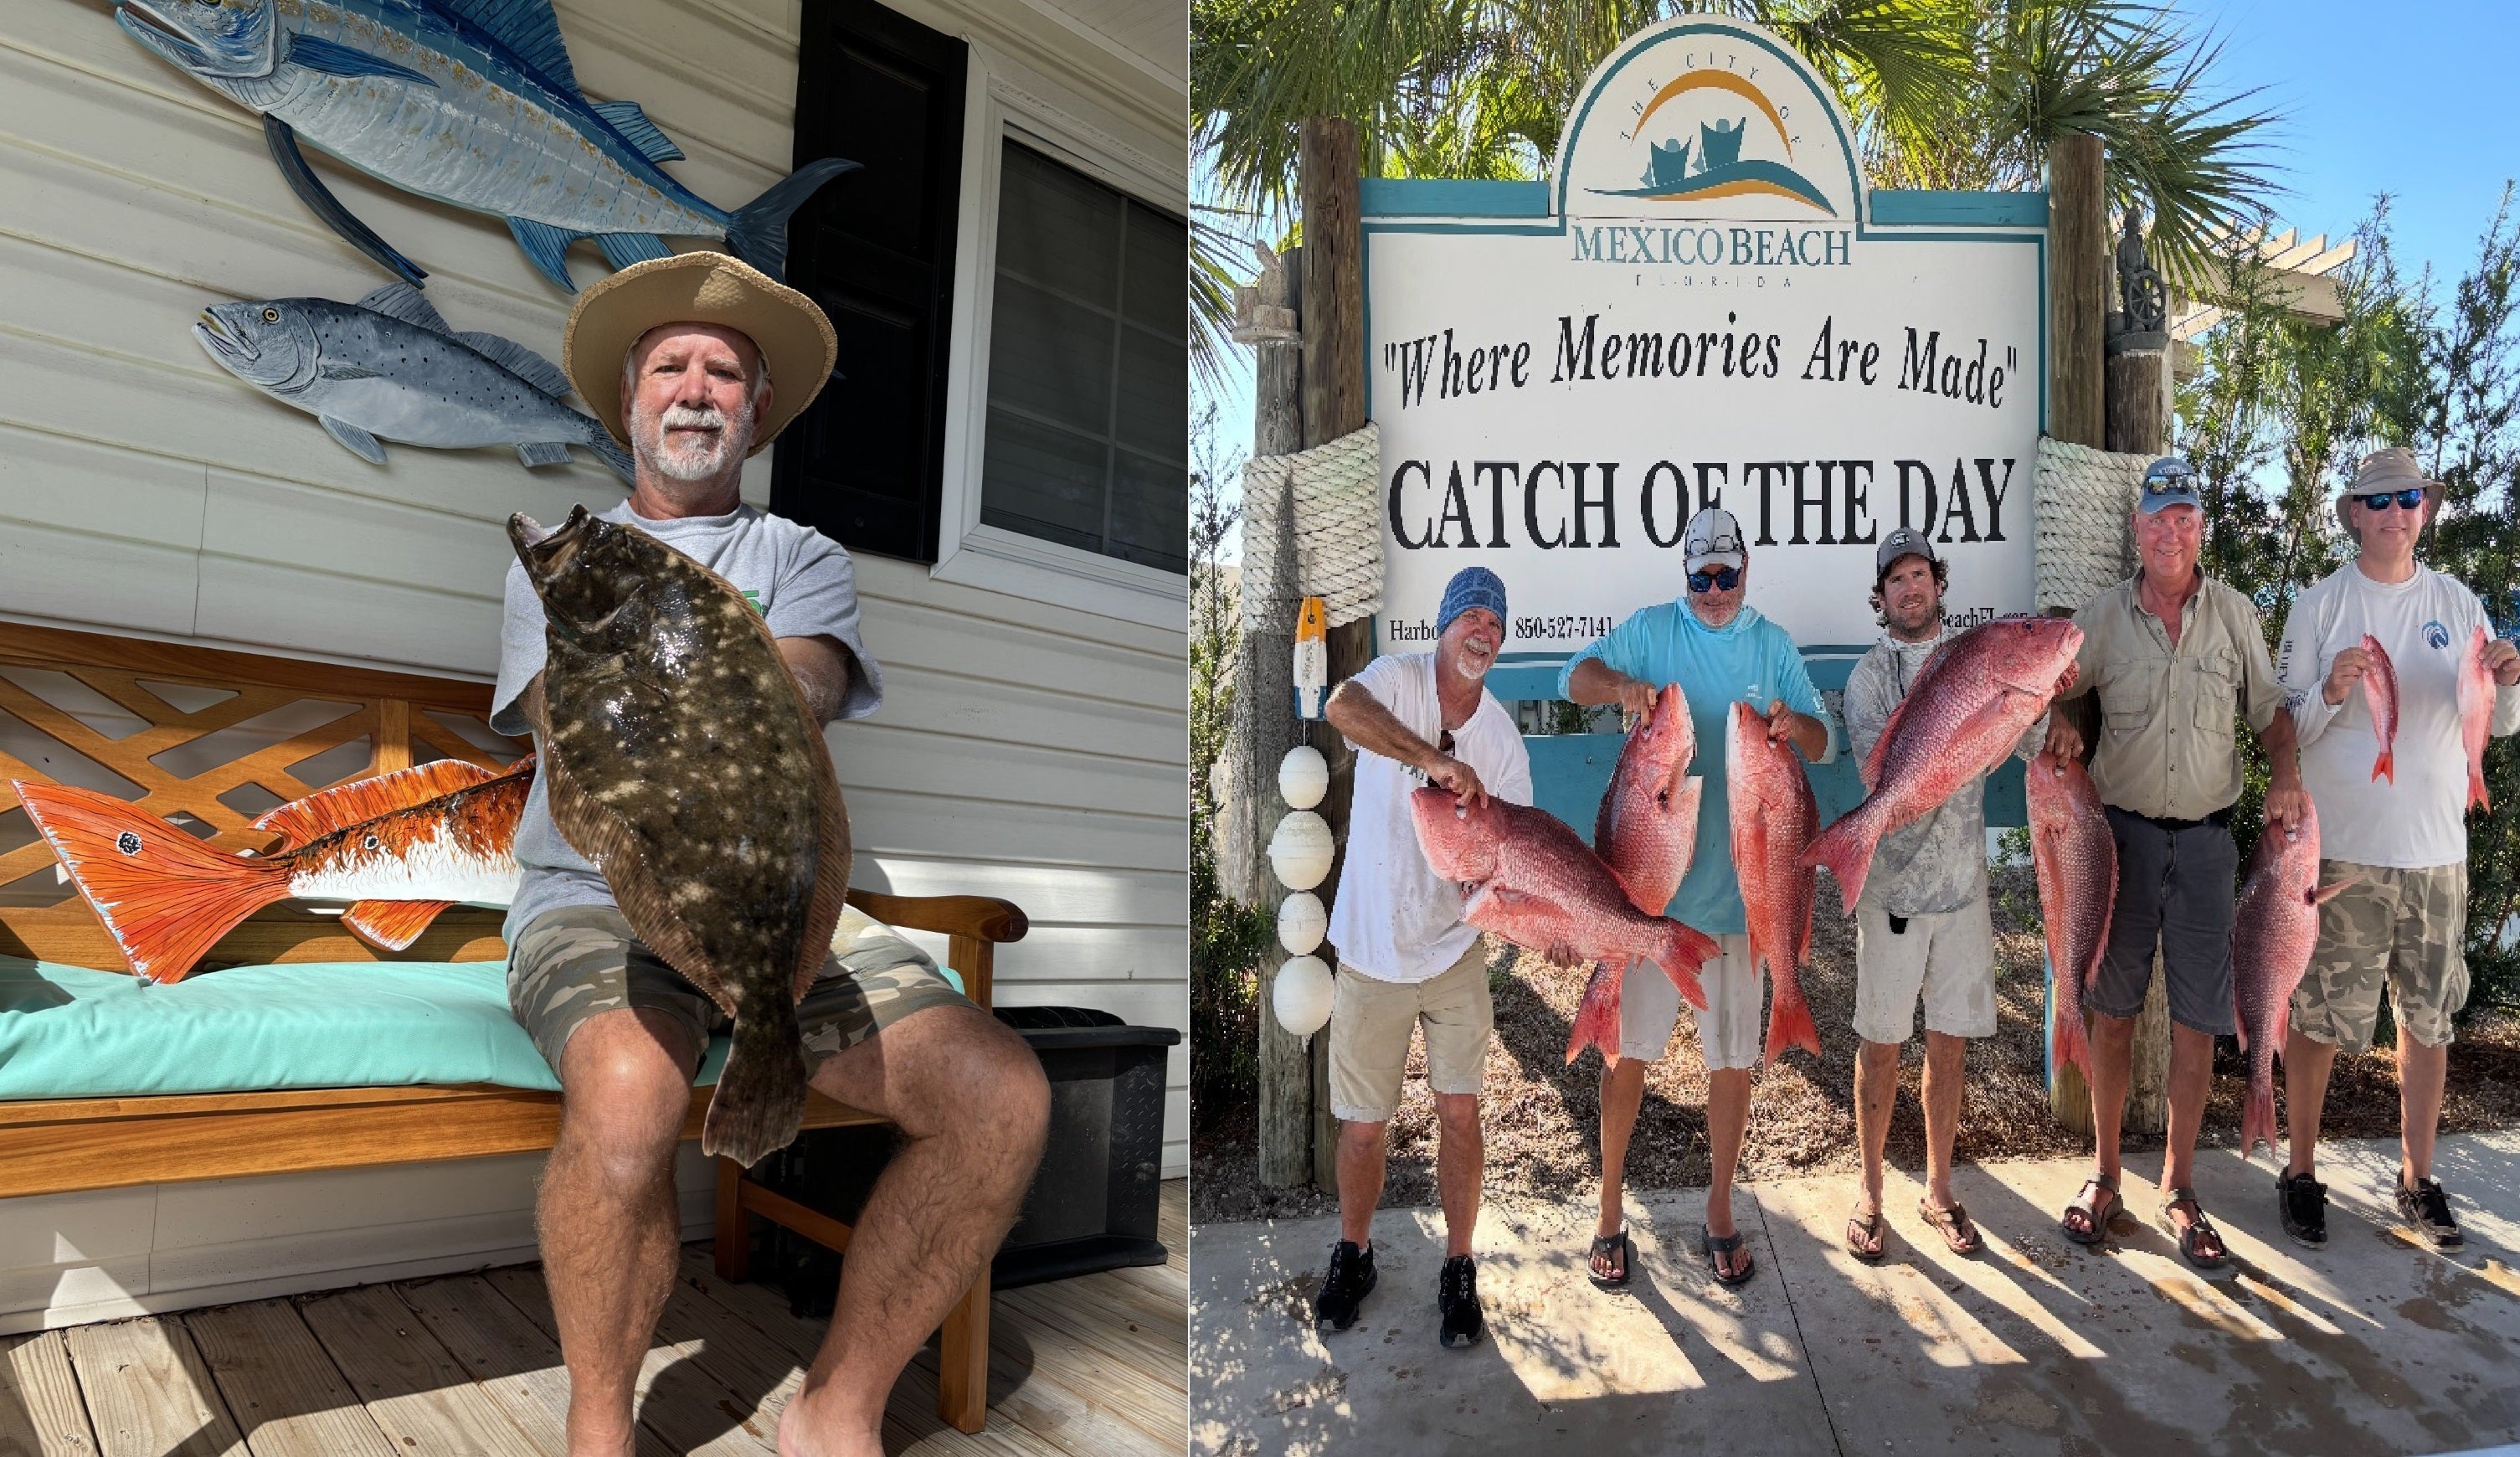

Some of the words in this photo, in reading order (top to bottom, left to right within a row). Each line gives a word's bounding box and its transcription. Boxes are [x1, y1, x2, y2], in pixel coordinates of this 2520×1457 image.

[1619, 78, 1659, 141] THE
[1685, 51, 1759, 80] CITY
[1779, 106, 1802, 144] OF
[1571, 224, 1724, 265] MEXICO
[1728, 228, 1852, 267] BEACH
[1385, 327, 1530, 410] "Where
[1550, 310, 1781, 383] Memories
[1800, 315, 1880, 386] Are
[1897, 326, 2017, 409] Made"
[1387, 460, 1621, 550] CATCH
[1640, 460, 1728, 548] OF
[1743, 460, 1877, 546] THE
[1893, 457, 2016, 543] DAY
[1389, 619, 1439, 641] Harbo
[1515, 615, 1612, 639] 850-527-7141
